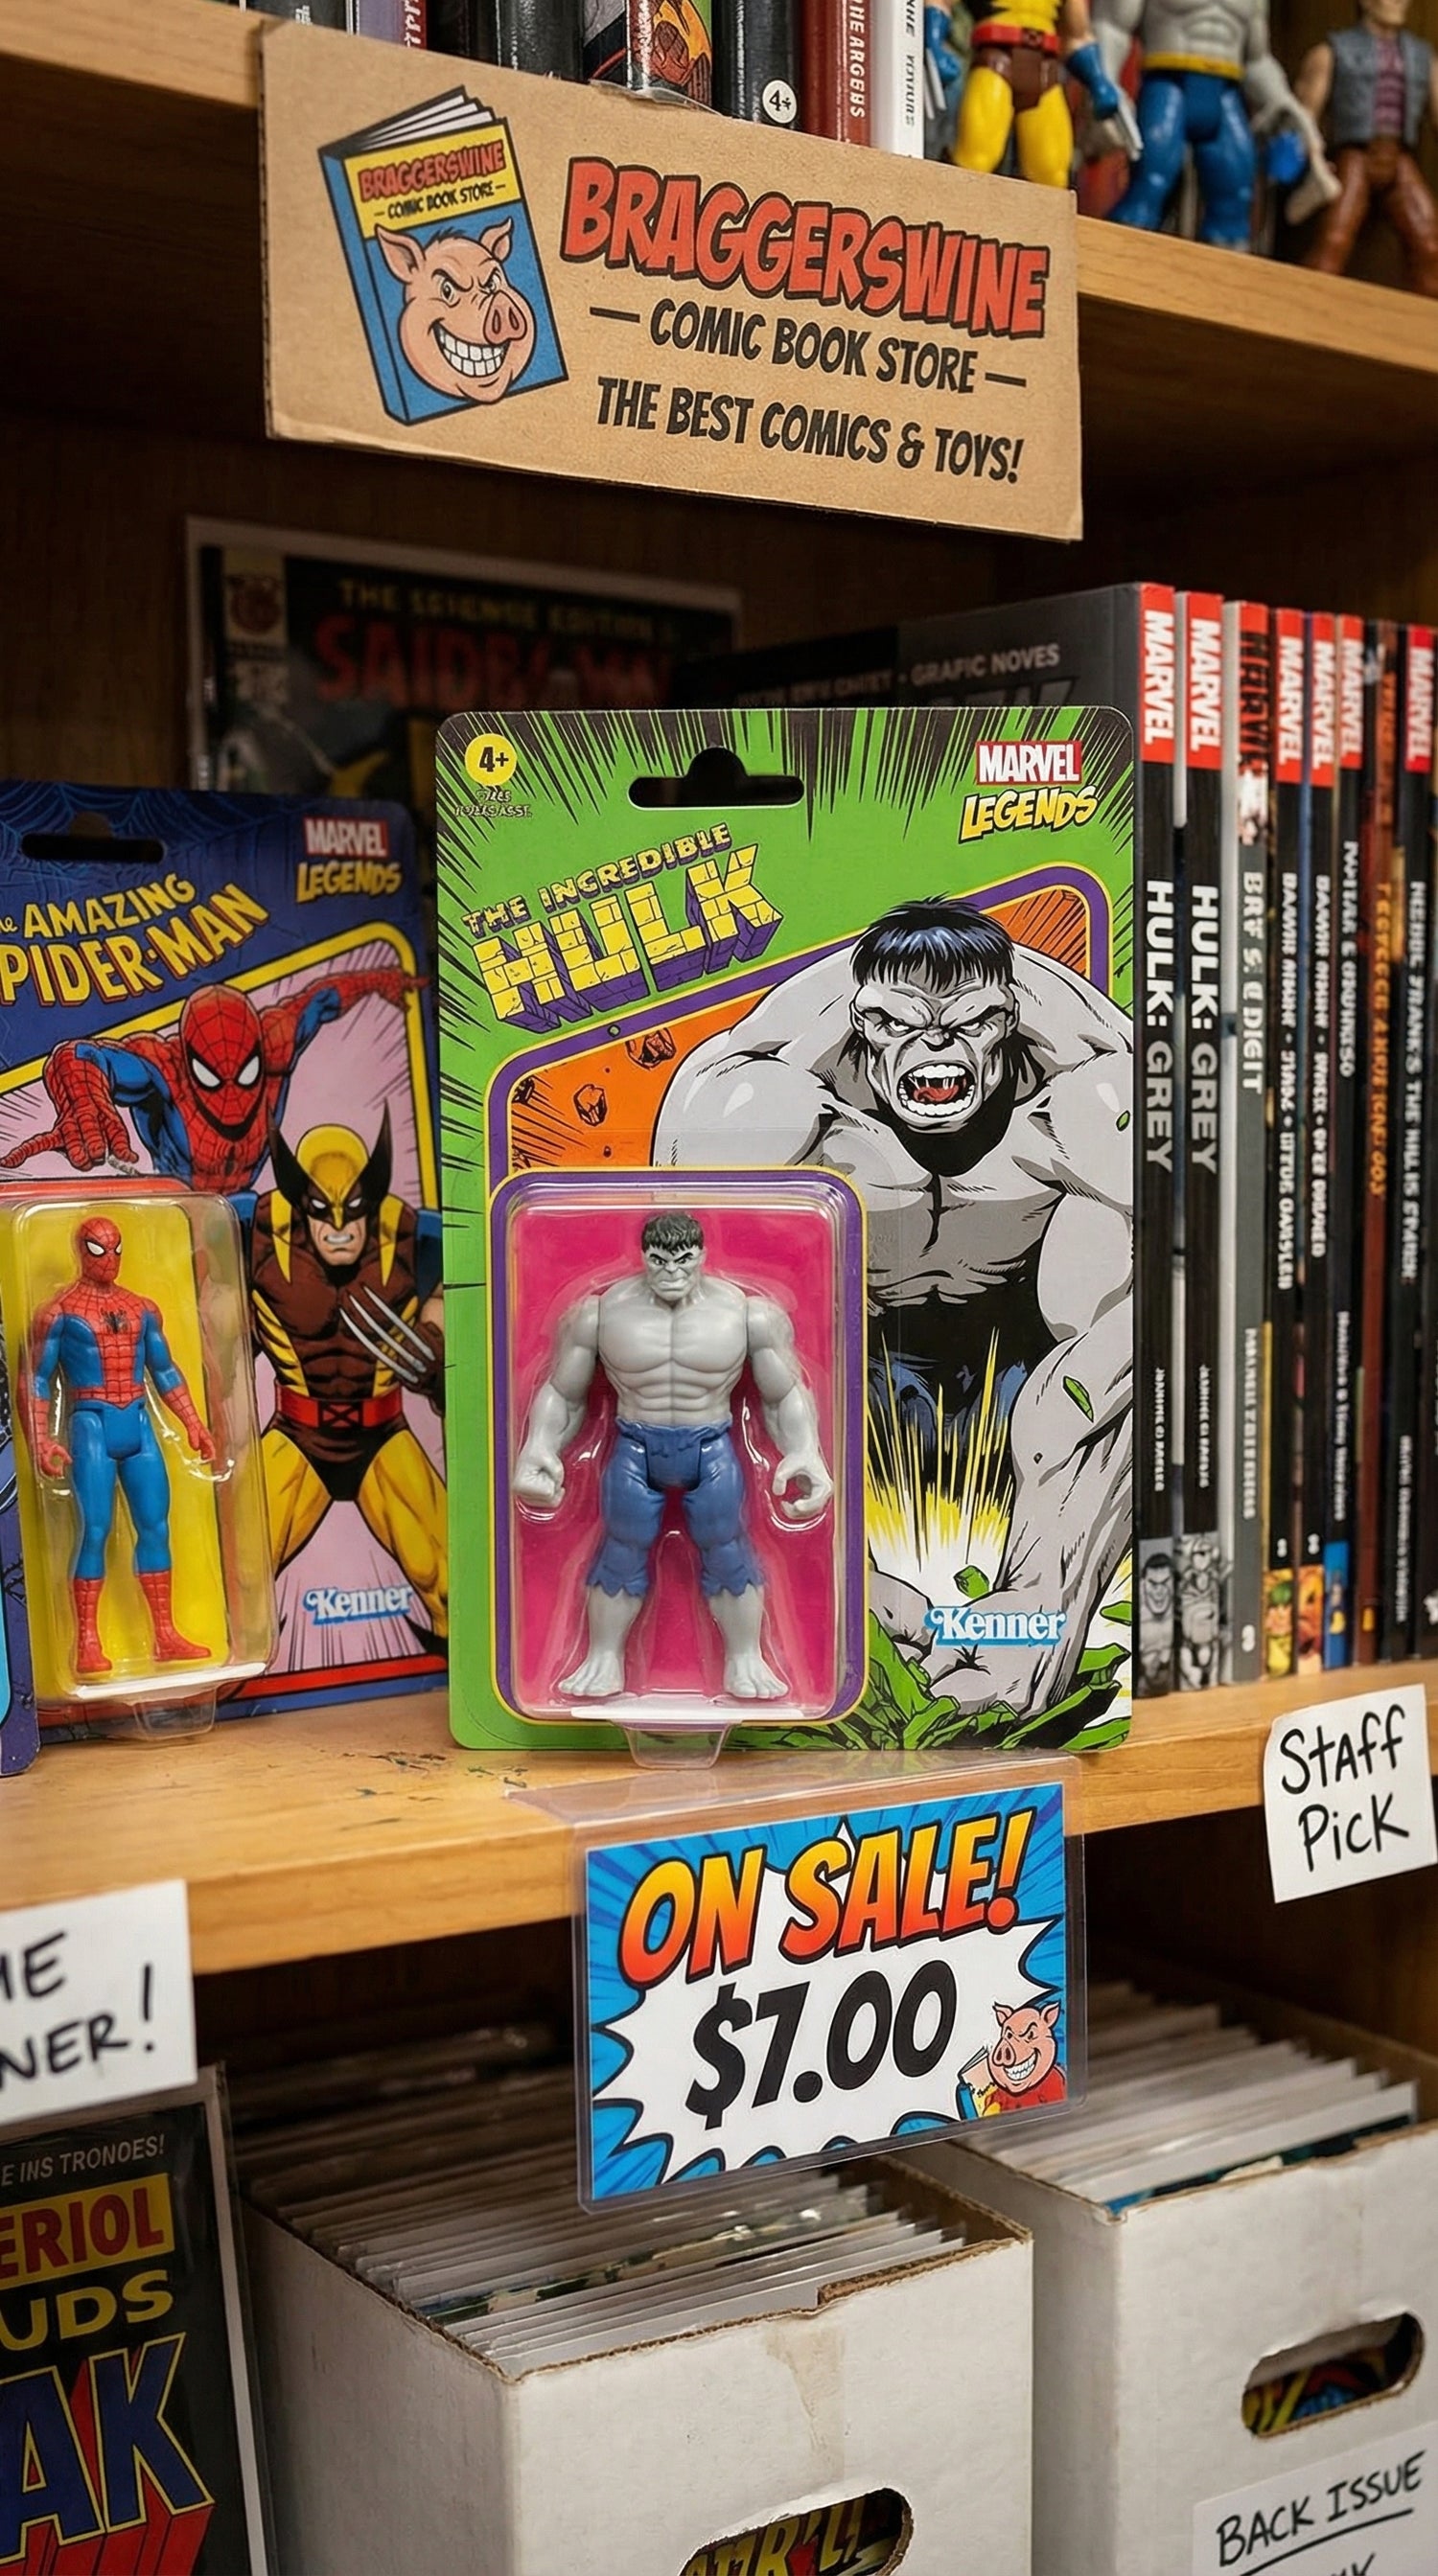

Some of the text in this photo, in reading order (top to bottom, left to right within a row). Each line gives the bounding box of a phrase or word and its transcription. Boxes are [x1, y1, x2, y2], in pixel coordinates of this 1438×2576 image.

[358, 140, 506, 202] BRAGGERSWINE
[388, 181, 494, 218] COMIC BOOK STORE
[561, 157, 1051, 339] BRAGGERSWINE
[650, 299, 978, 393] COMIC BOOK STORE
[597, 377, 1024, 484] THE BEST COMICS & TOYS!
[991, 644, 1060, 675] NOVES
[1145, 610, 1174, 746] MARVEL
[1191, 617, 1222, 752] MARVEL
[1279, 636, 1303, 765] MARVEL
[1312, 640, 1334, 770] MARVEL
[1342, 639, 1363, 759] MARVEL
[1408, 649, 1433, 761] MARVEL
[479, 747, 509, 772] 4+
[979, 744, 1079, 782] MARVEL
[305, 818, 387, 857] MARVEL
[959, 785, 1099, 844] LEGENDS
[24, 873, 197, 938] AMAZING
[296, 860, 402, 903] LEGENDS
[462, 822, 731, 937] THE INCREDIBLE
[472, 843, 783, 1033] HULK
[1147, 880, 1173, 1172] HULK: GREY
[1192, 885, 1218, 1174] HULK: GREY
[303, 1585, 414, 1625] Kenner
[923, 1605, 1067, 1647] Kenner
[618, 1807, 1038, 1990] ON SALE!
[685, 1960, 957, 2130] $7.00
[19, 2155, 54, 2184] INS
[1217, 2450, 1426, 2567] BACK ISSUE
